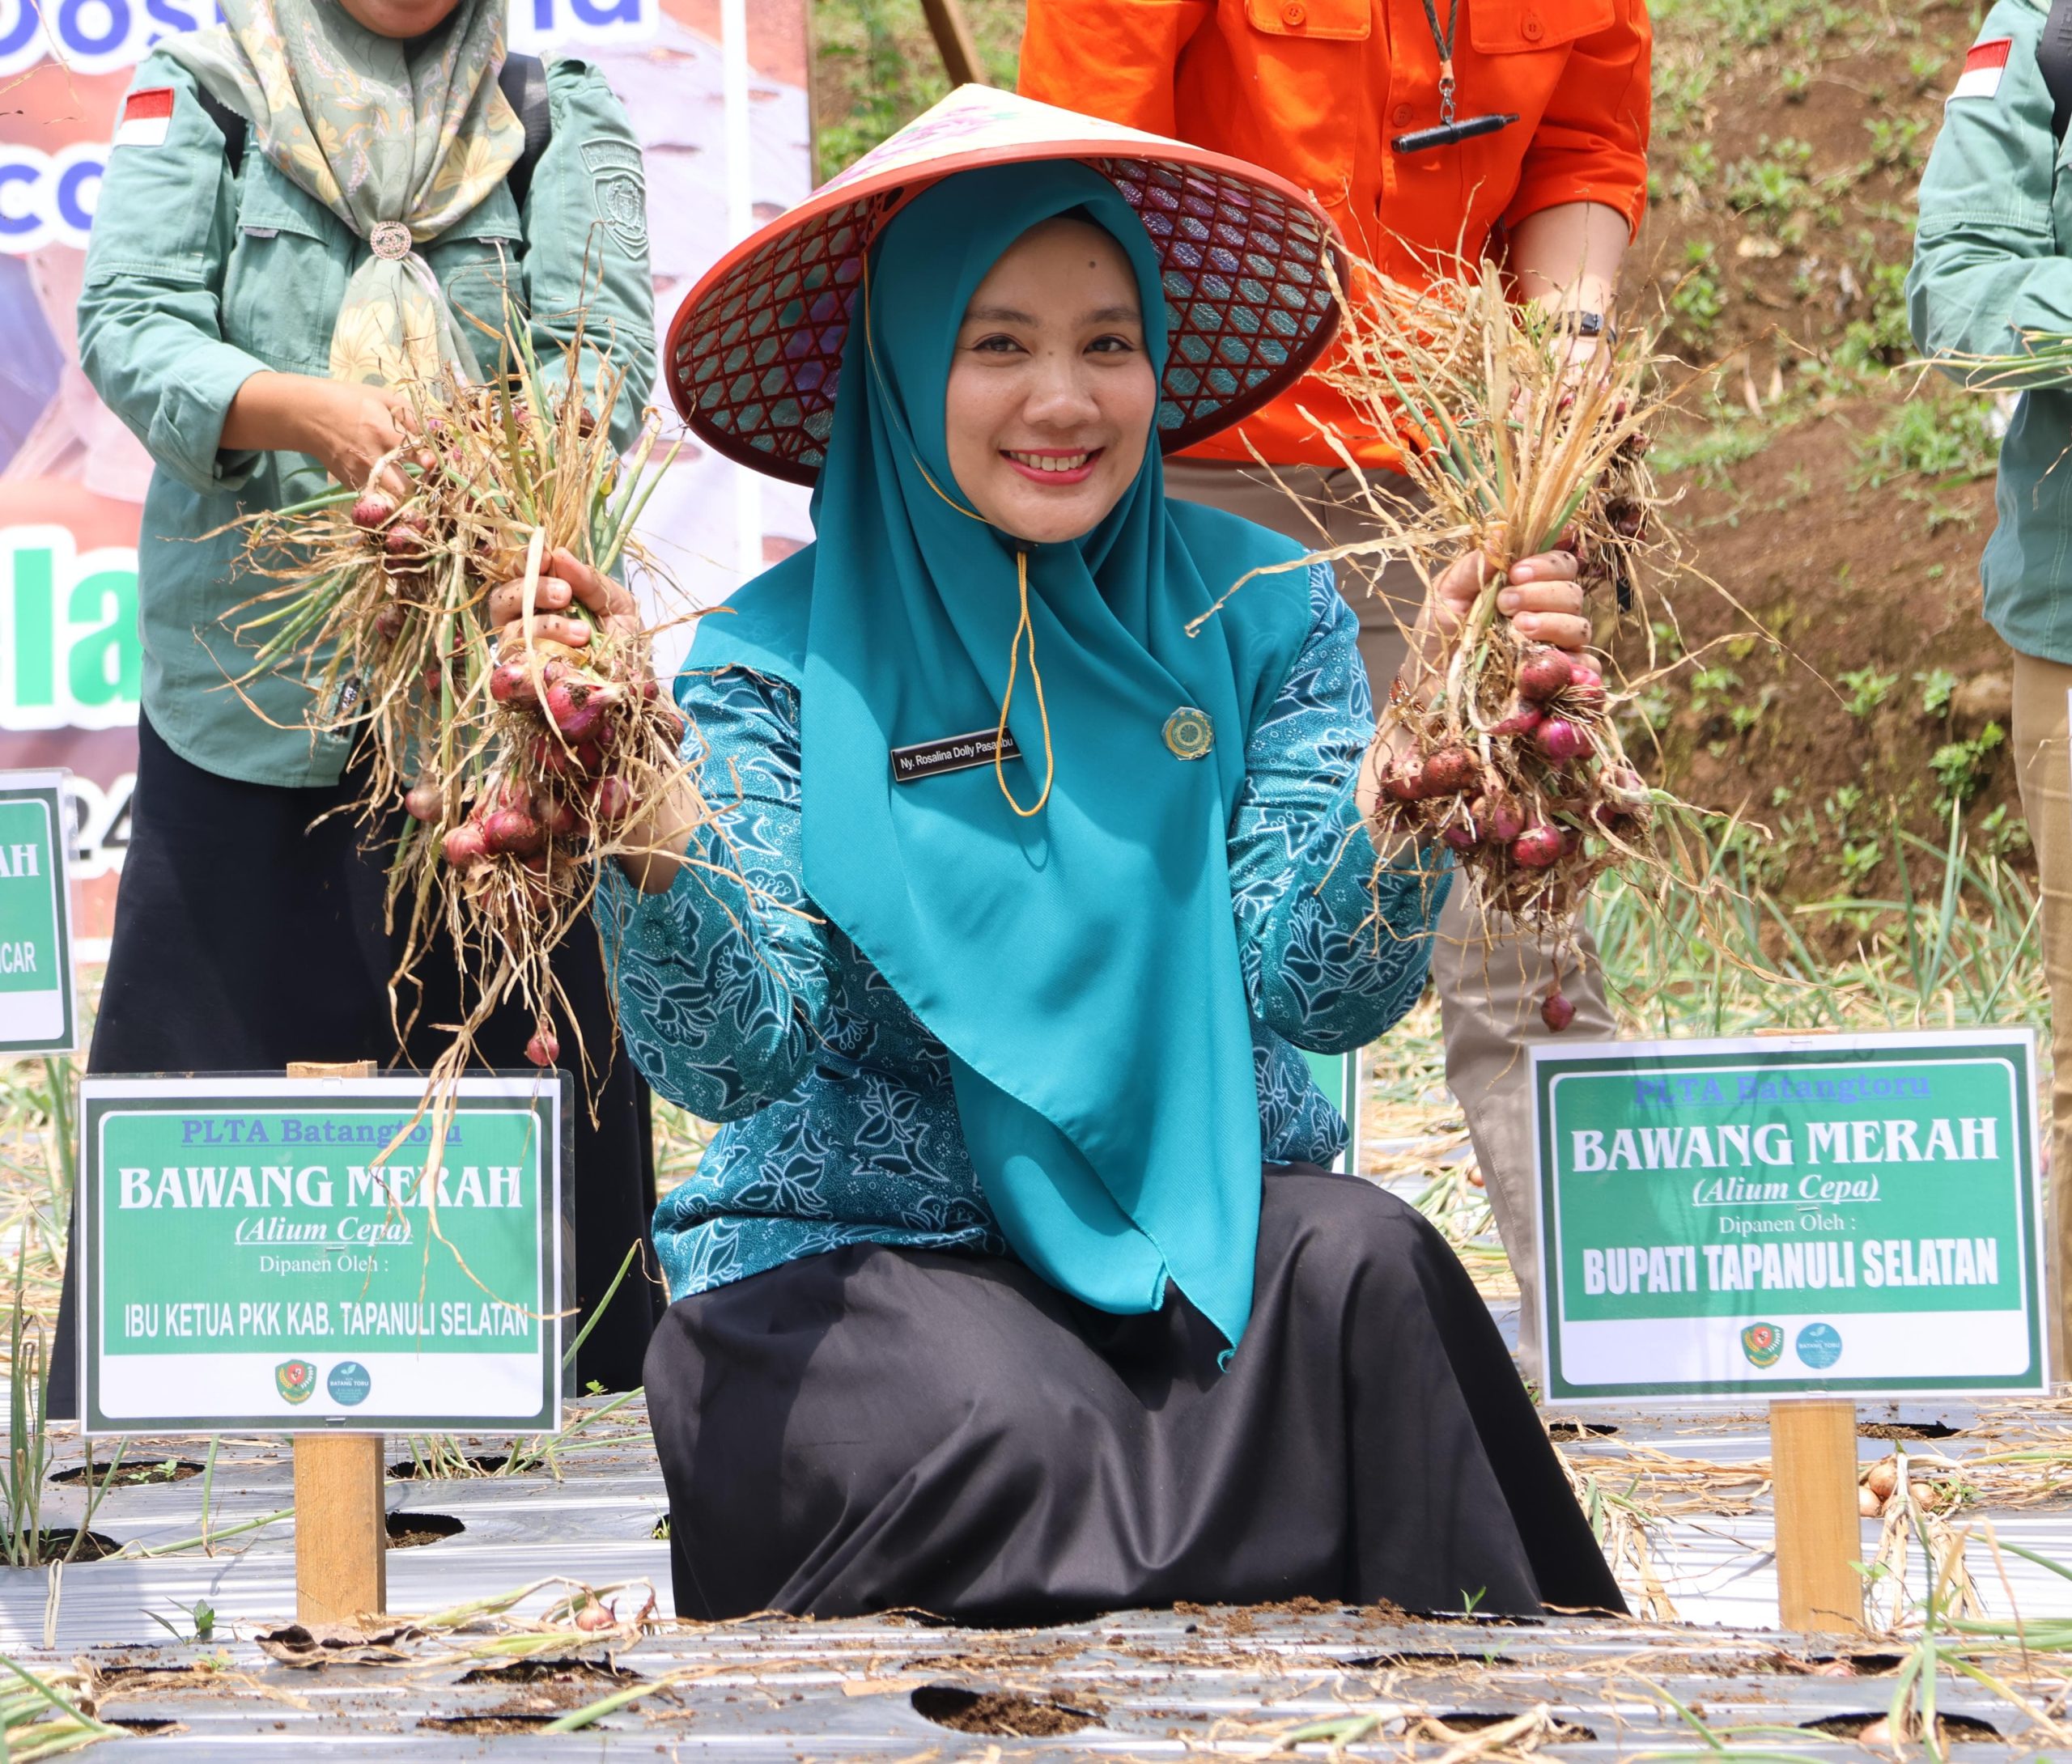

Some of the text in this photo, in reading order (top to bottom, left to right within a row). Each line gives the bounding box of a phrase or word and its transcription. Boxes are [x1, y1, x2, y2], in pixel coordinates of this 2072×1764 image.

[900, 757, 915, 770] Ny.
[915, 750, 953, 765] Rosalina
[953, 744, 974, 758] Dolly
[1635, 1074, 1930, 1105] PLTA Batangtoru
[182, 1120, 270, 1143] PLTA
[1571, 1117, 1999, 1172] BAWANG MERAH
[119, 1165, 522, 1209] BAWANG MERAH
[1692, 1173, 1879, 1206] (Alium Cepa)
[235, 1216, 411, 1246] (Alium Cepa)
[1719, 1216, 1794, 1237] Dipanen
[1800, 1213, 1845, 1231] Oleh
[260, 1256, 331, 1276] Dipanen
[337, 1255, 378, 1272] Oleh
[1583, 1238, 1998, 1295] BUPATI TAPANULI SELATAN
[125, 1302, 529, 1338] IBU KETUA PKK KAB. TAPANULI SELATAN
